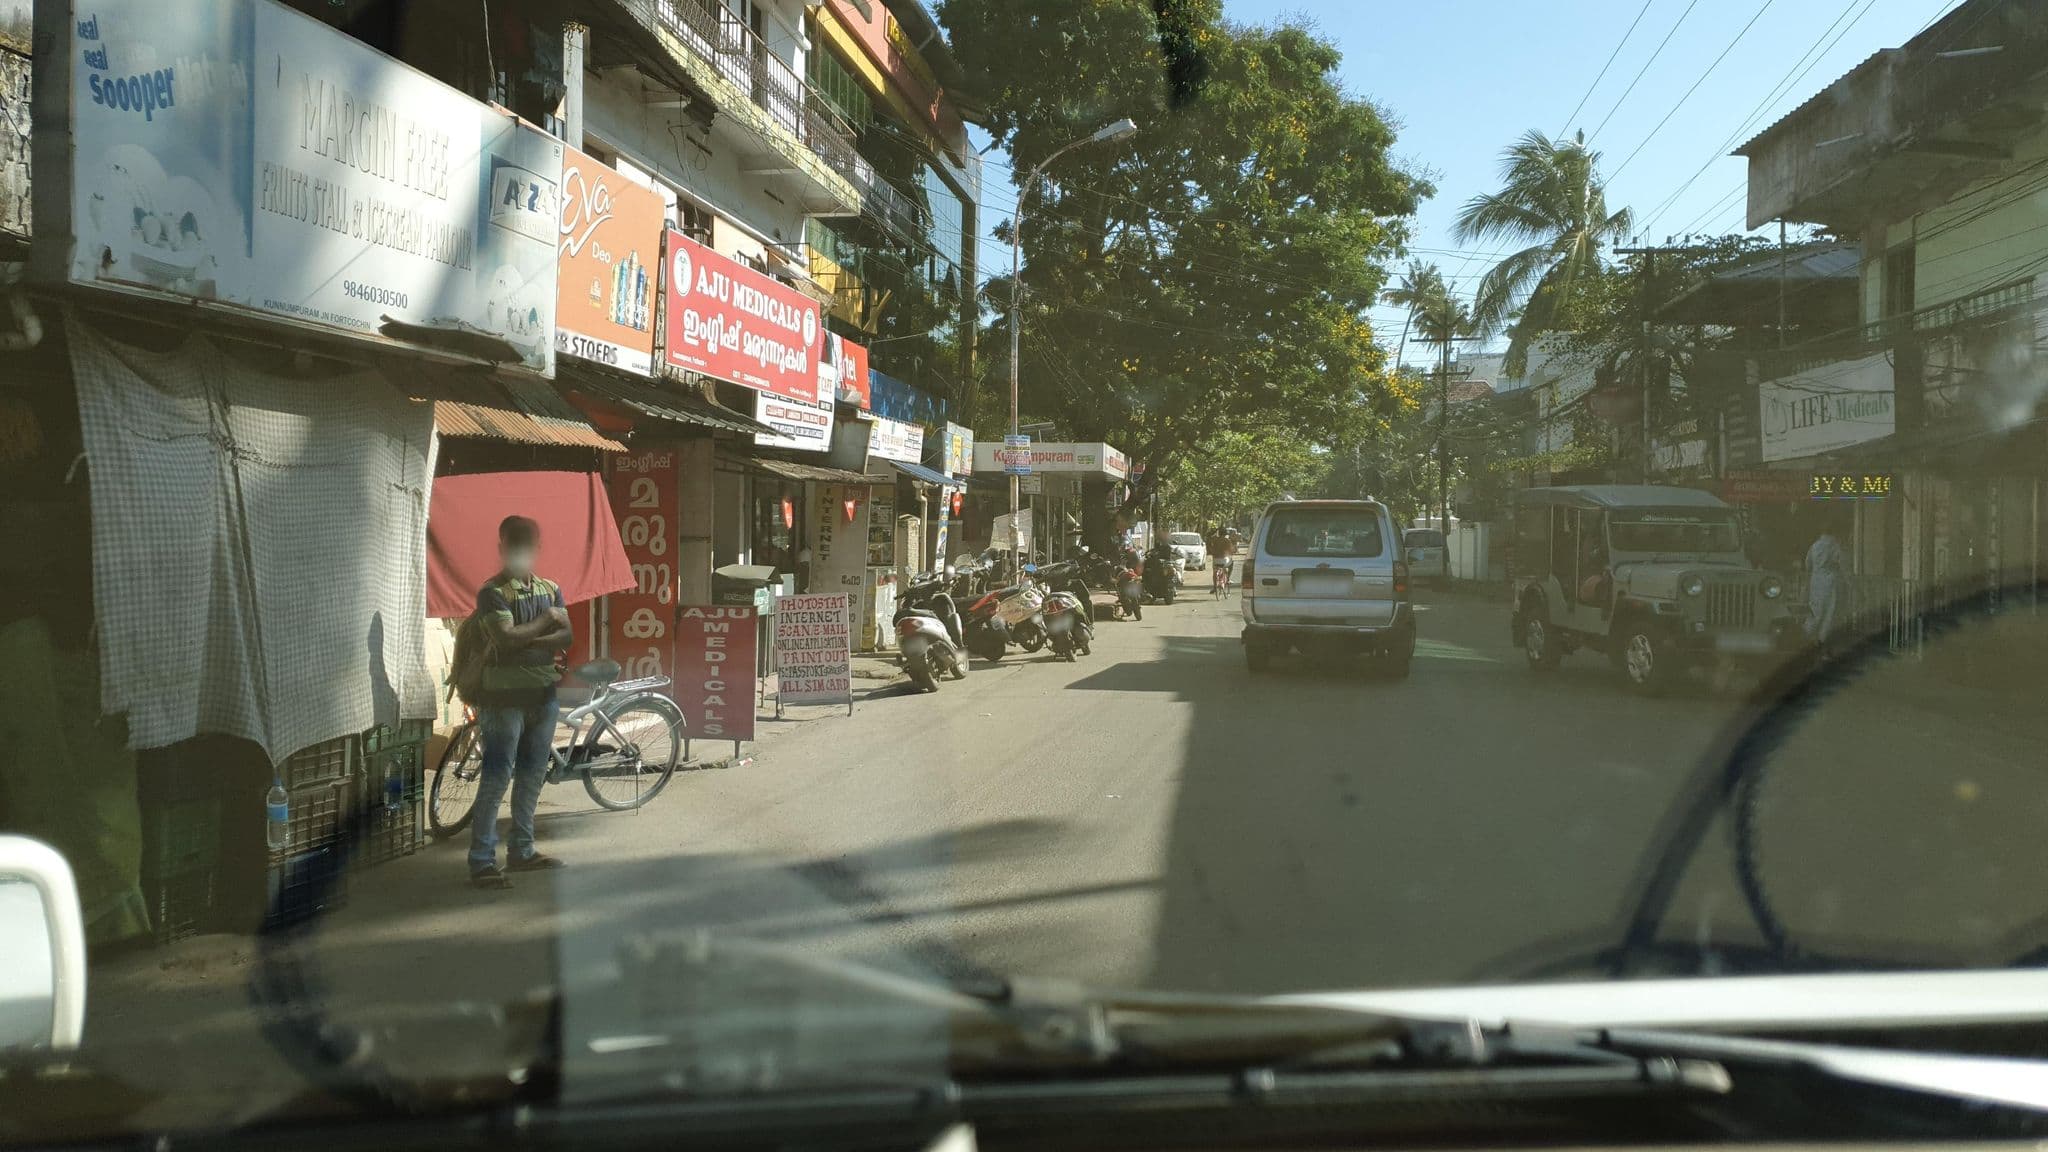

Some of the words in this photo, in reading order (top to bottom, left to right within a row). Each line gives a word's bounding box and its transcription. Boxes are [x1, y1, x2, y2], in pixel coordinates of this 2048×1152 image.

[300, 73, 397, 183] MARGIN
[403, 120, 450, 201] FREE
[260, 161, 308, 222] FRUITS
[312, 176, 349, 235] STALL
[592, 241, 611, 263] Deo
[343, 279, 408, 309] 9846030500
[696, 264, 730, 303] AJU
[733, 281, 802, 333] MEDICALS
[1791, 393, 1832, 430] LIFE
[1836, 393, 1890, 422] Medicals
[1840, 476, 1857, 494] &
[684, 607, 750, 619] AJU
[780, 595, 846, 611] PHOTOSTAT
[780, 610, 841, 624] INTERNET
[703, 622, 730, 736] MEDICALS
[780, 680, 802, 693] ALL
